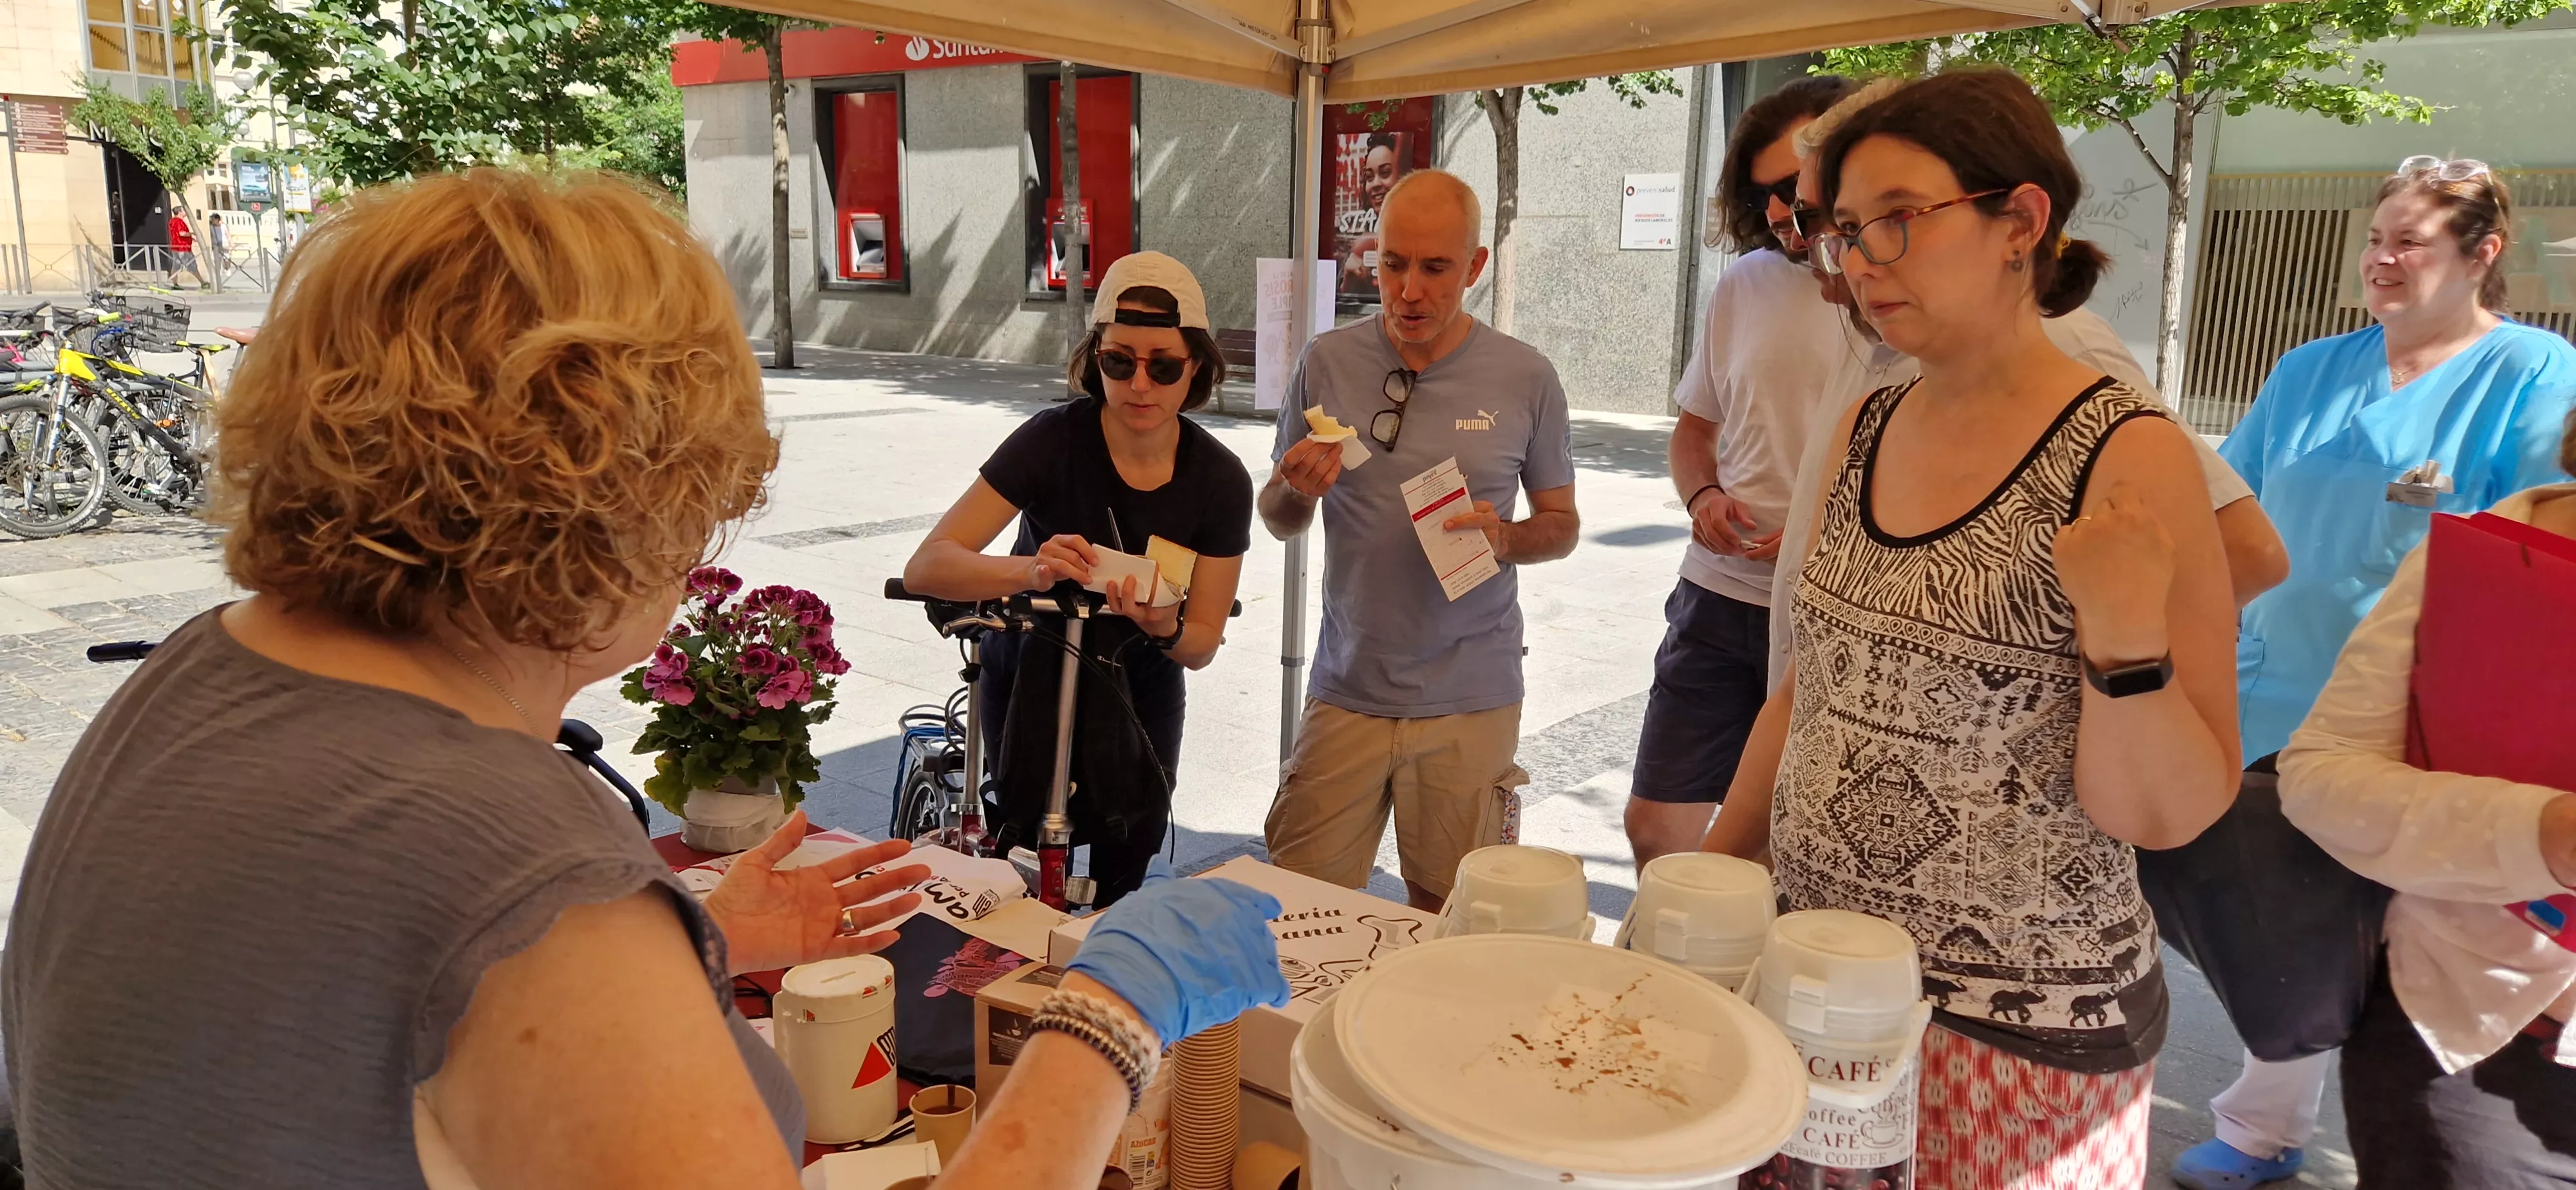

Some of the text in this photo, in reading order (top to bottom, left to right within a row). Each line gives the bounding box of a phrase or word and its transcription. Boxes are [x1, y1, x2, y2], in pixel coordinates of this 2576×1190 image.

[1340, 207, 1379, 234] STA
[1455, 419, 1490, 430] PUMA
[1807, 1054, 1881, 1082] CAFÉ
[1804, 1108, 1857, 1126] offee
[1803, 1127, 1861, 1149] CAFÉ
[1824, 1151, 1888, 1166] COFFEE
